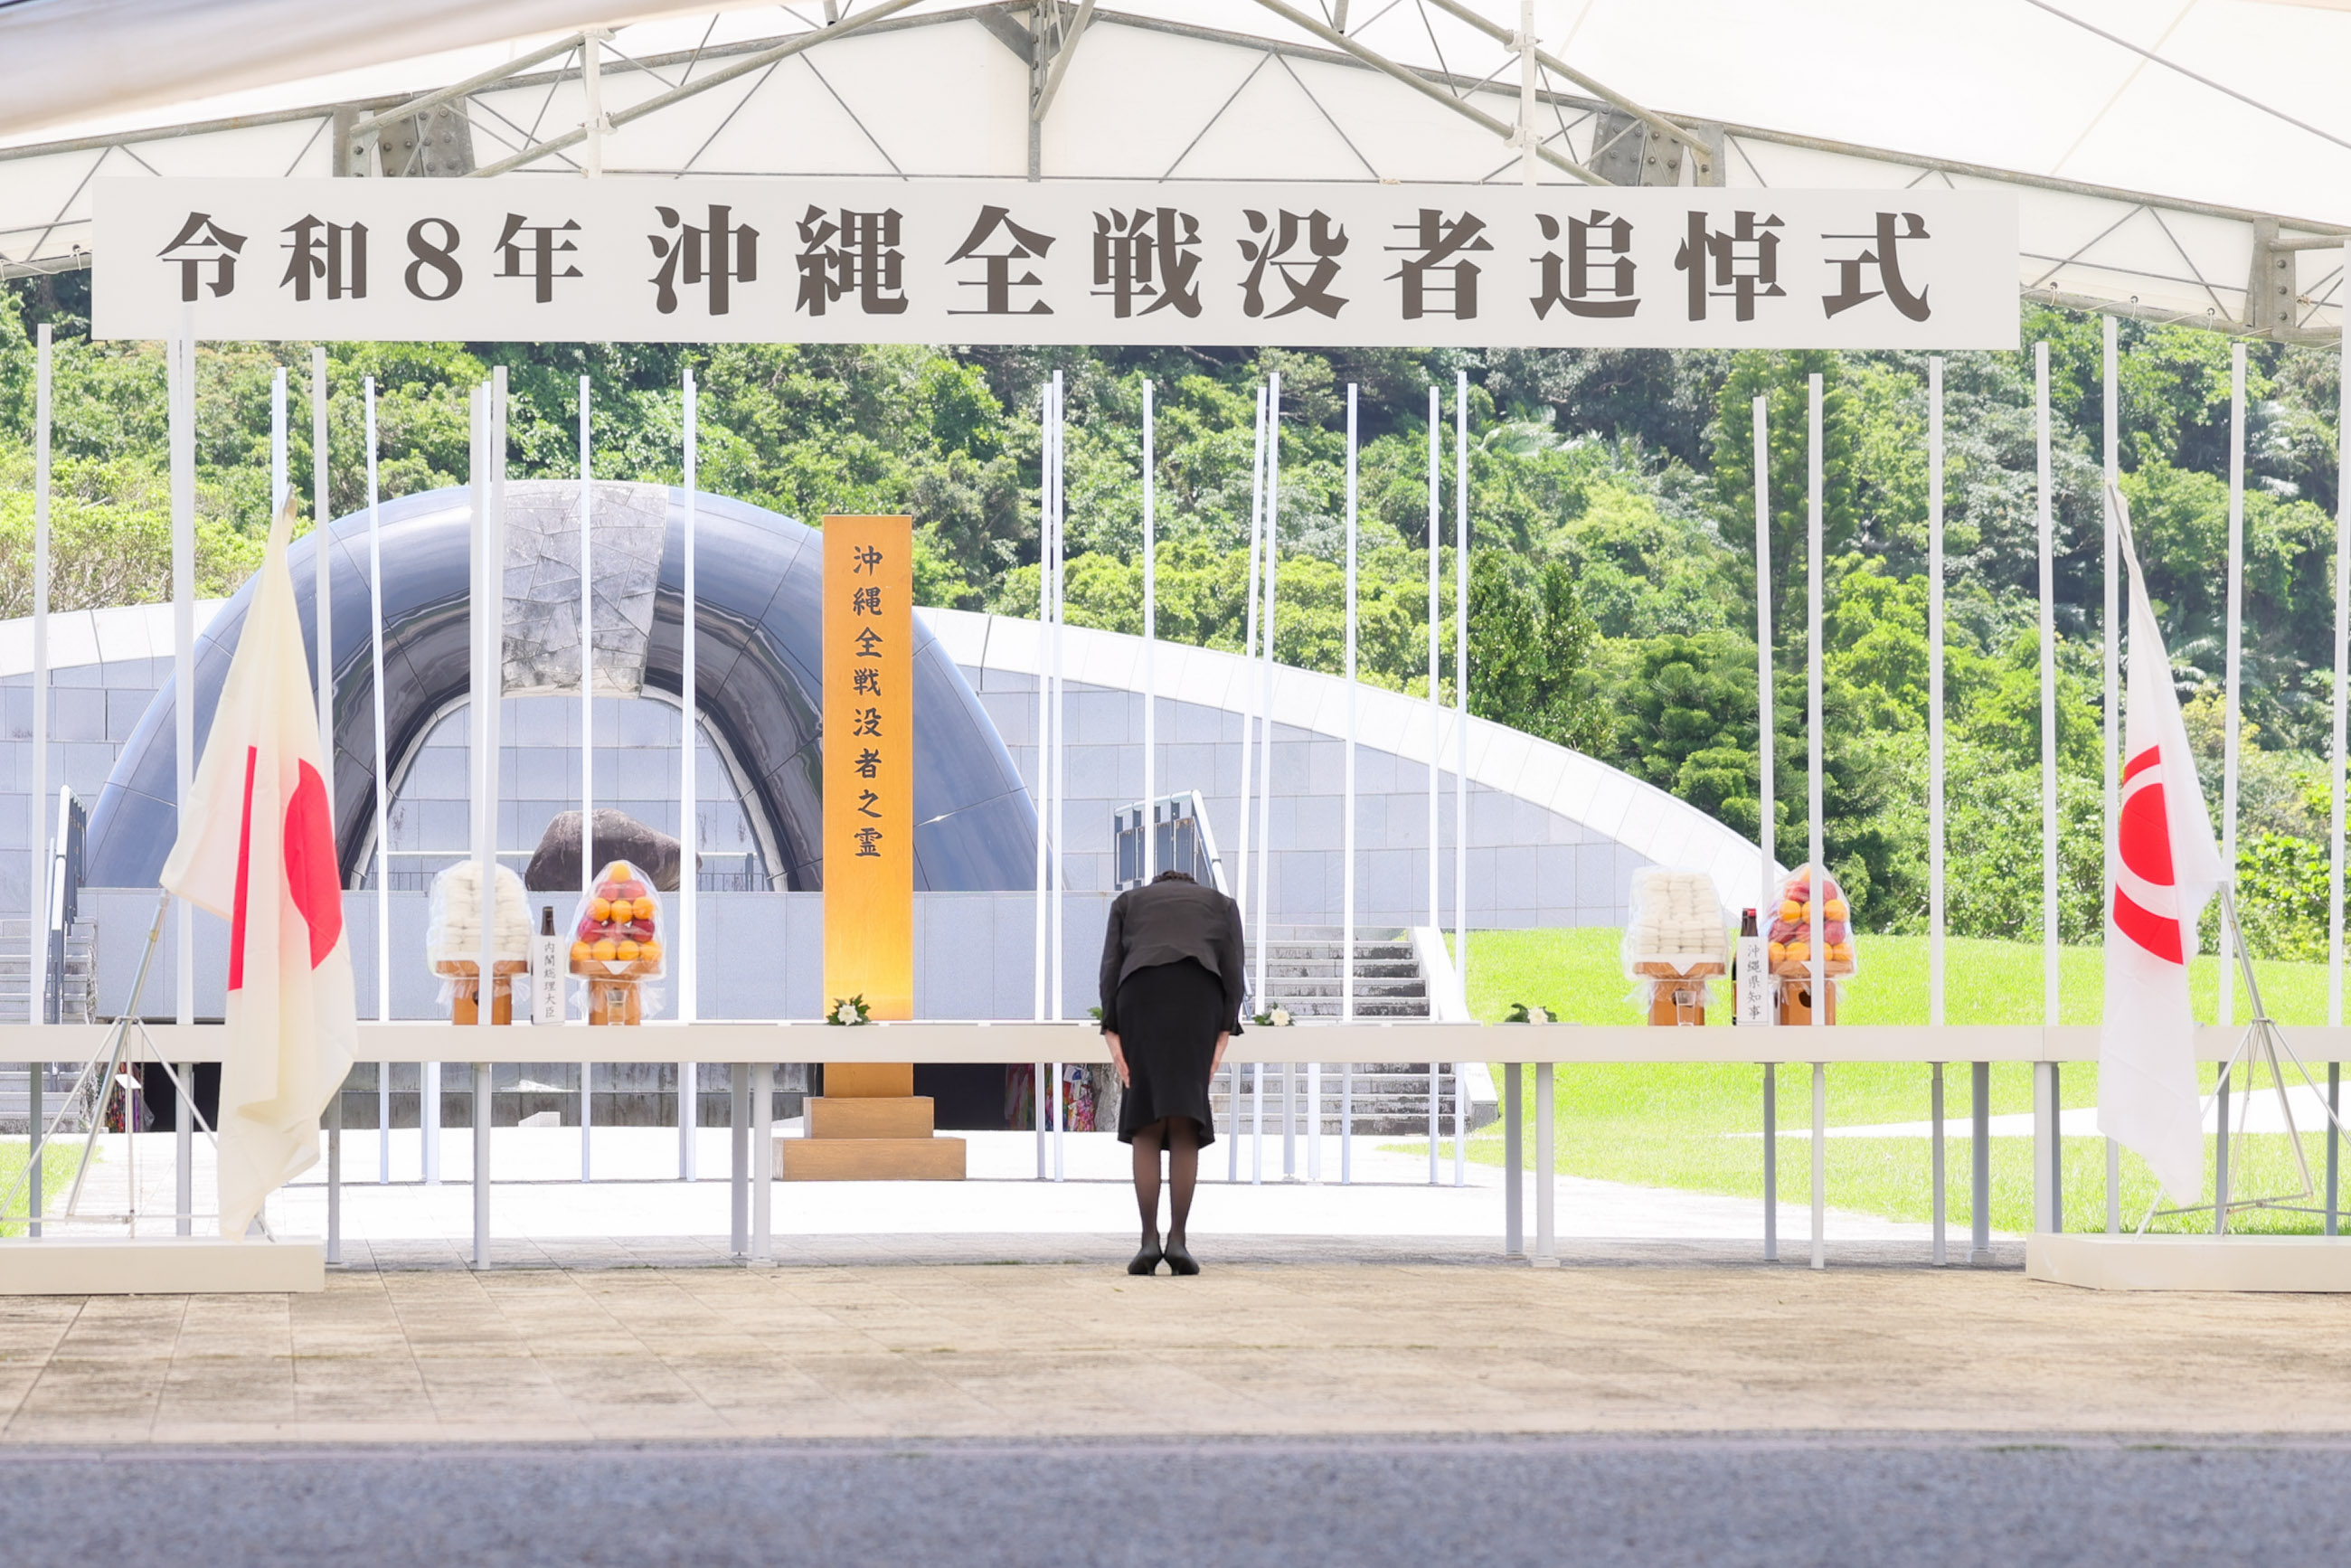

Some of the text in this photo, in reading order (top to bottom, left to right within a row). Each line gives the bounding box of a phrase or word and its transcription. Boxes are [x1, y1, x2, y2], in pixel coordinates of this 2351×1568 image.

[156, 204, 1931, 322] 令和8年 沖縄全戦没者追悼式
[853, 545, 883, 857] 沖縄全戦没者之霊
[544, 941, 557, 1018] 内閣総理大臣
[1747, 944, 1761, 1020] 沖縄県知事
